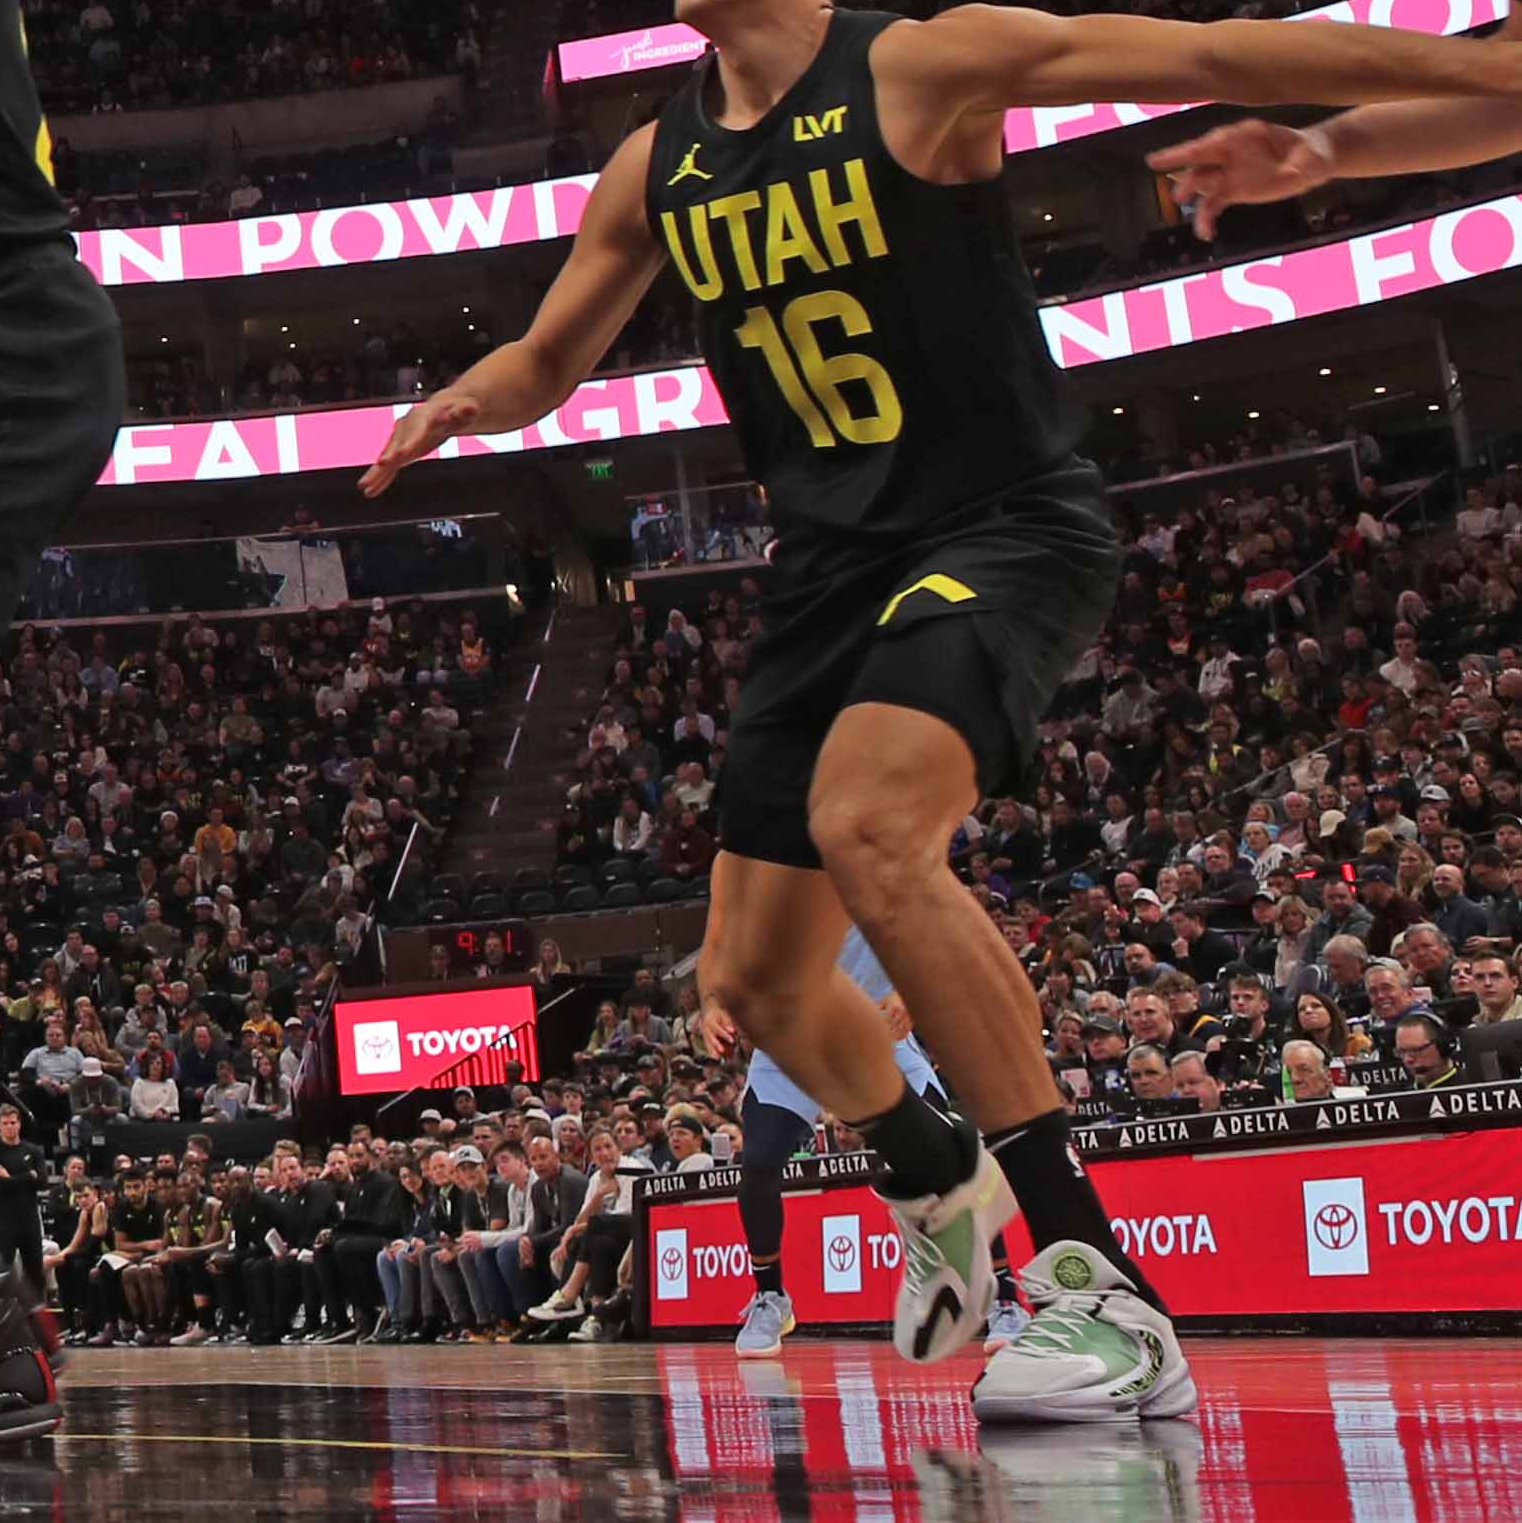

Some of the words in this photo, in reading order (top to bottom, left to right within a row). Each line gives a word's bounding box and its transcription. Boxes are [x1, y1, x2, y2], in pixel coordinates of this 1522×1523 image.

[792, 105, 849, 143] LVT
[660, 157, 890, 303] UTAH
[734, 288, 904, 449] 16
[406, 1024, 517, 1059] TOYOTA
[1362, 1067, 1408, 1086] DELTA
[654, 1175, 687, 1194] DELTA
[708, 1169, 742, 1188] DELTA
[829, 1155, 870, 1175] DELTA
[1135, 1121, 1190, 1145] DELTA
[1230, 1112, 1290, 1135] DELTA
[1335, 1100, 1400, 1125] DELTA
[1450, 1089, 1522, 1115] DELTA
